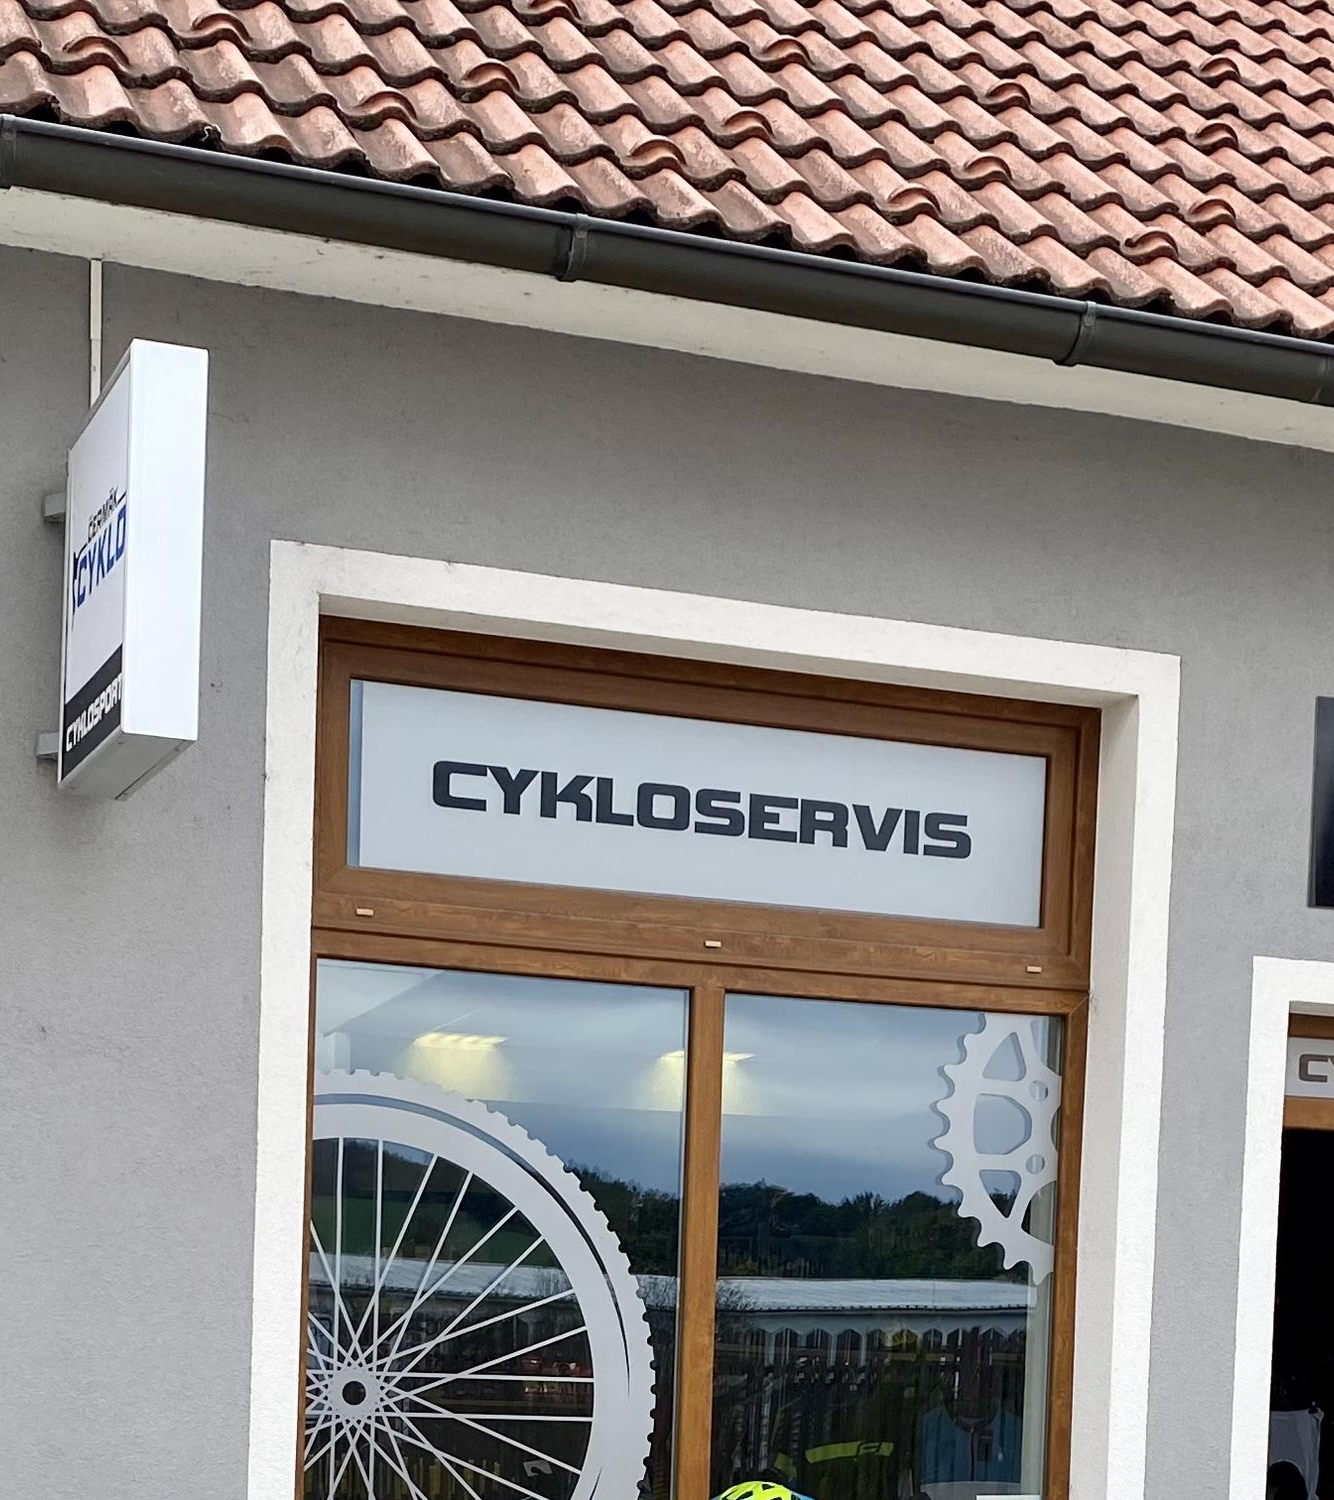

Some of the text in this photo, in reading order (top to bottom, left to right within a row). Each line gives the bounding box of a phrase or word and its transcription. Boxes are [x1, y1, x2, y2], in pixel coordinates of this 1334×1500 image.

[76, 503, 127, 608] CYKLO
[66, 673, 123, 753] CYKLOSPORT
[432, 760, 972, 860] CYKLOSERVIS
